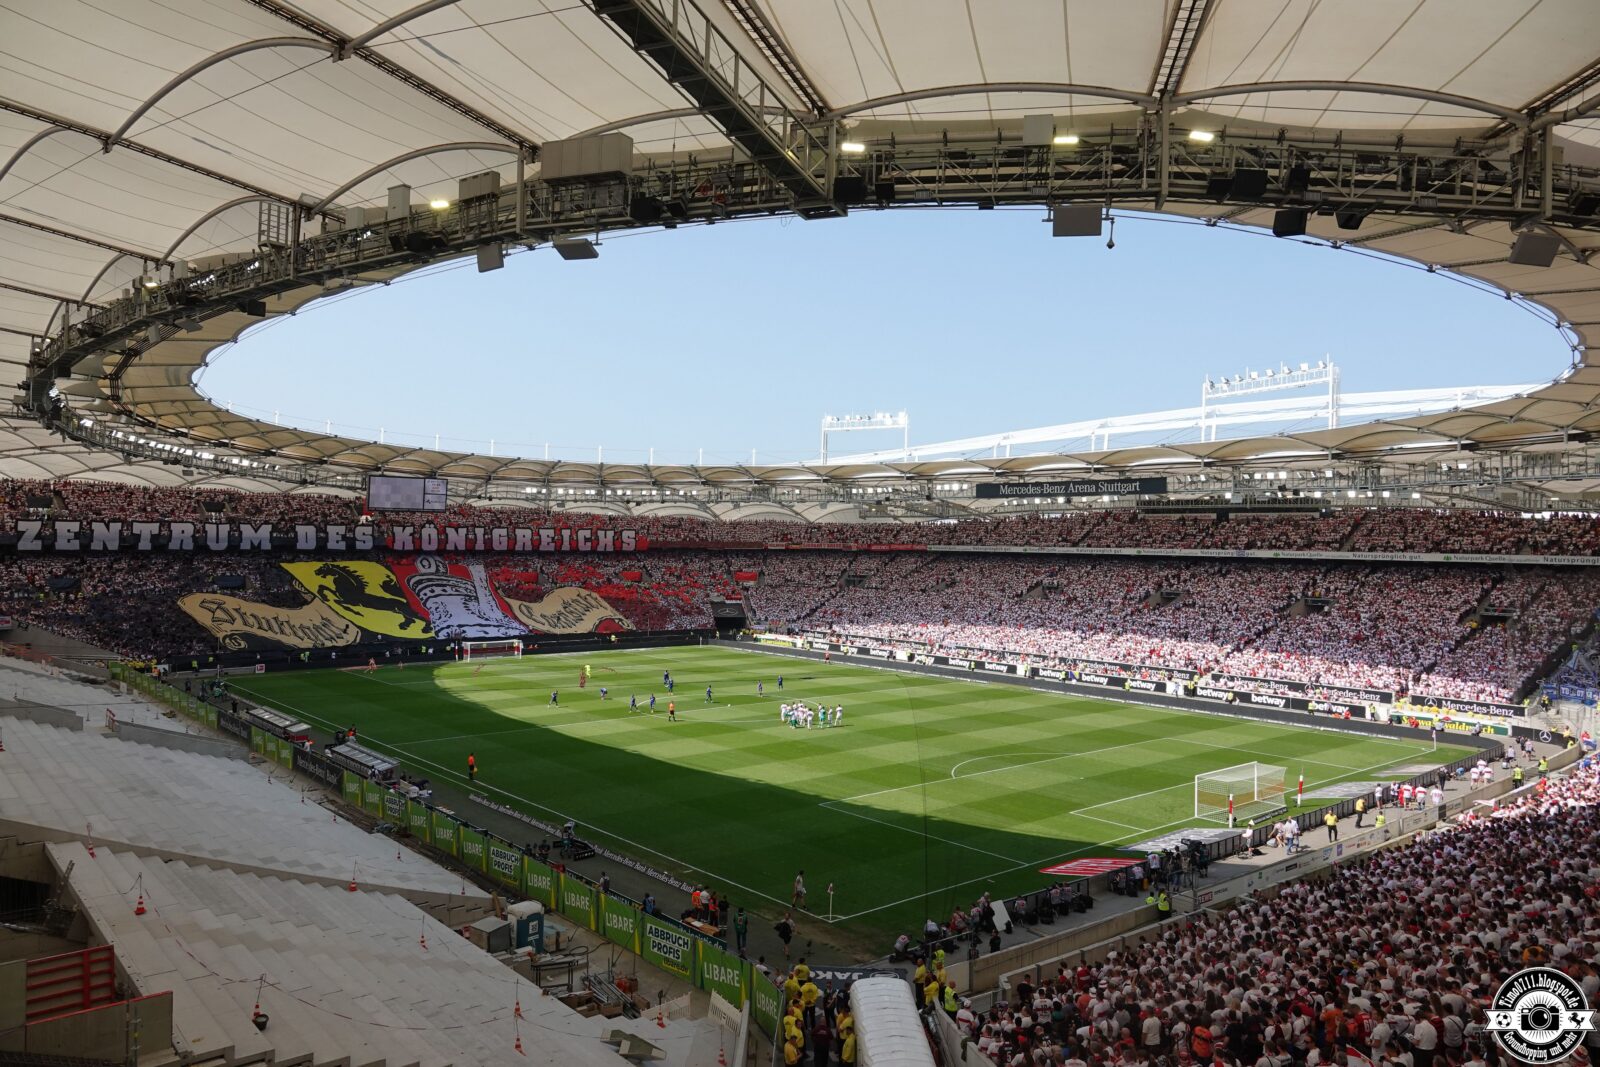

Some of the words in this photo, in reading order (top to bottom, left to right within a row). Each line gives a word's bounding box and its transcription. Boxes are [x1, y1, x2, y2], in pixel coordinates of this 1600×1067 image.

[1000, 483, 1066, 494] Mercedes-Benz
[1068, 483, 1096, 493] Arena
[1098, 481, 1140, 494] Stuttgart
[17, 520, 272, 550] ZENTRUM
[295, 524, 374, 550] DES
[393, 522, 636, 551] KÖNIGREICHS
[1353, 552, 1407, 560] Natursprünglich
[985, 662, 1008, 672] betway
[1082, 673, 1109, 685] betway
[1197, 688, 1228, 700] betway
[1251, 693, 1286, 708] betway
[1442, 700, 1514, 716] Mercedes-Benz
[463, 841, 482, 856] LIBARE
[491, 848, 519, 864] ABBRUCH
[494, 859, 513, 875] PROFIS
[527, 873, 551, 890] LIBARE
[646, 868, 682, 888] Mercedes-Benz
[564, 892, 591, 911] LIBARE
[605, 912, 634, 933] LIBARE
[648, 926, 689, 949] ABBRUCH
[652, 941, 681, 960] PROFIS
[704, 962, 740, 987] LIBARE
[756, 990, 778, 1020] LIBARE
